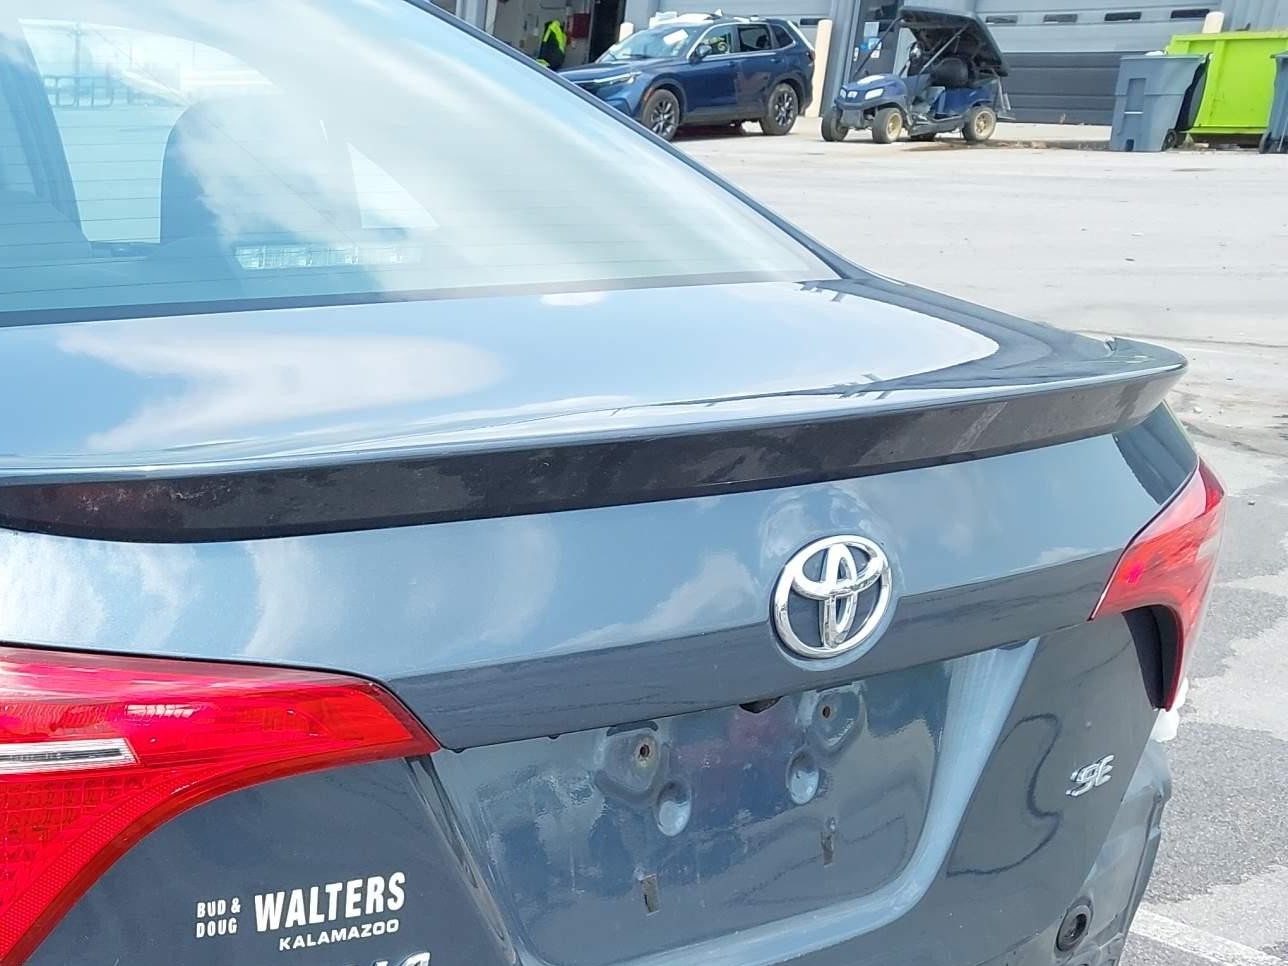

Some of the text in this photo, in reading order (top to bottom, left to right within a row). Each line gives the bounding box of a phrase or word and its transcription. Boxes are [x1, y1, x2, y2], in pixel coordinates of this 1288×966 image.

[1065, 754, 1114, 797] SE
[196, 871, 406, 932] BUD & WALTERS
[195, 918, 238, 938] DOUG
[279, 918, 400, 951] KALAMAZOO
